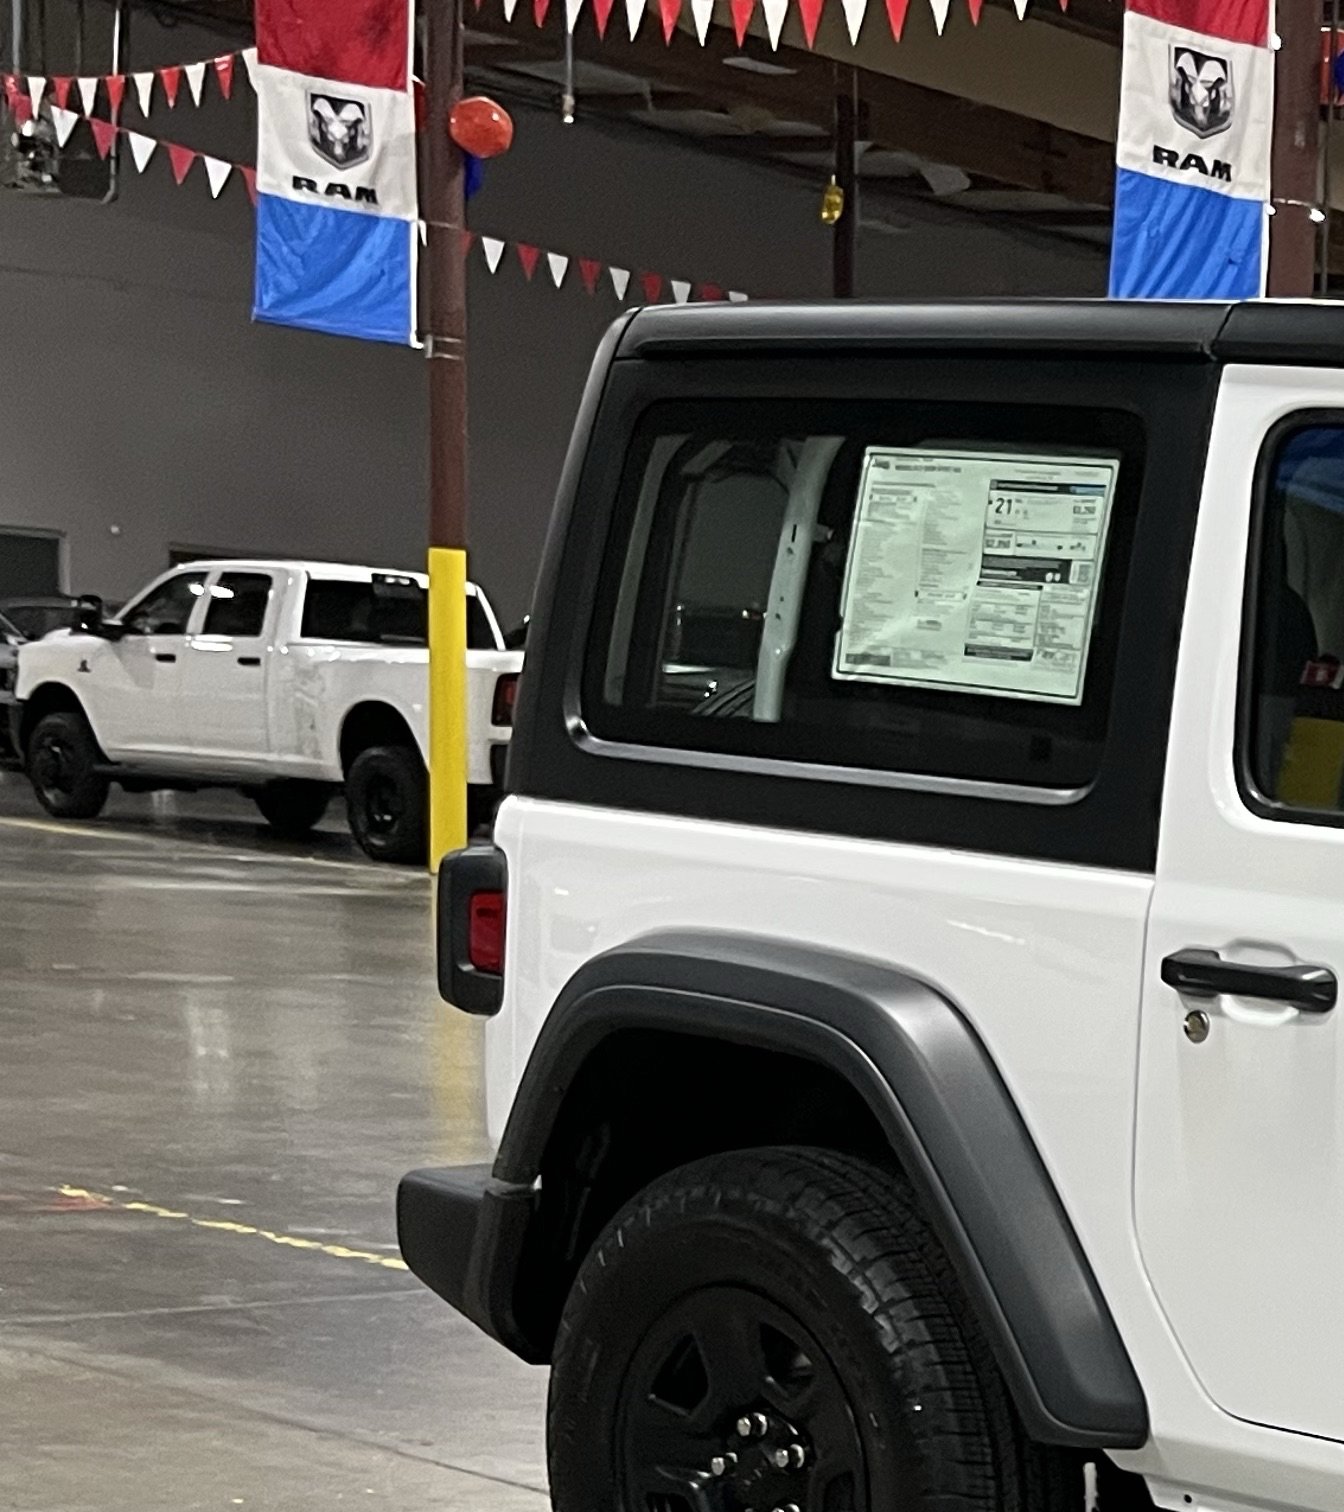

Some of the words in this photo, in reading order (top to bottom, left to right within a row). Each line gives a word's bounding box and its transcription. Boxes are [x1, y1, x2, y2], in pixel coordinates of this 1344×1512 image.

[1152, 145, 1233, 182] RAM
[292, 175, 379, 206] RAM
[995, 497, 1013, 515] 21
